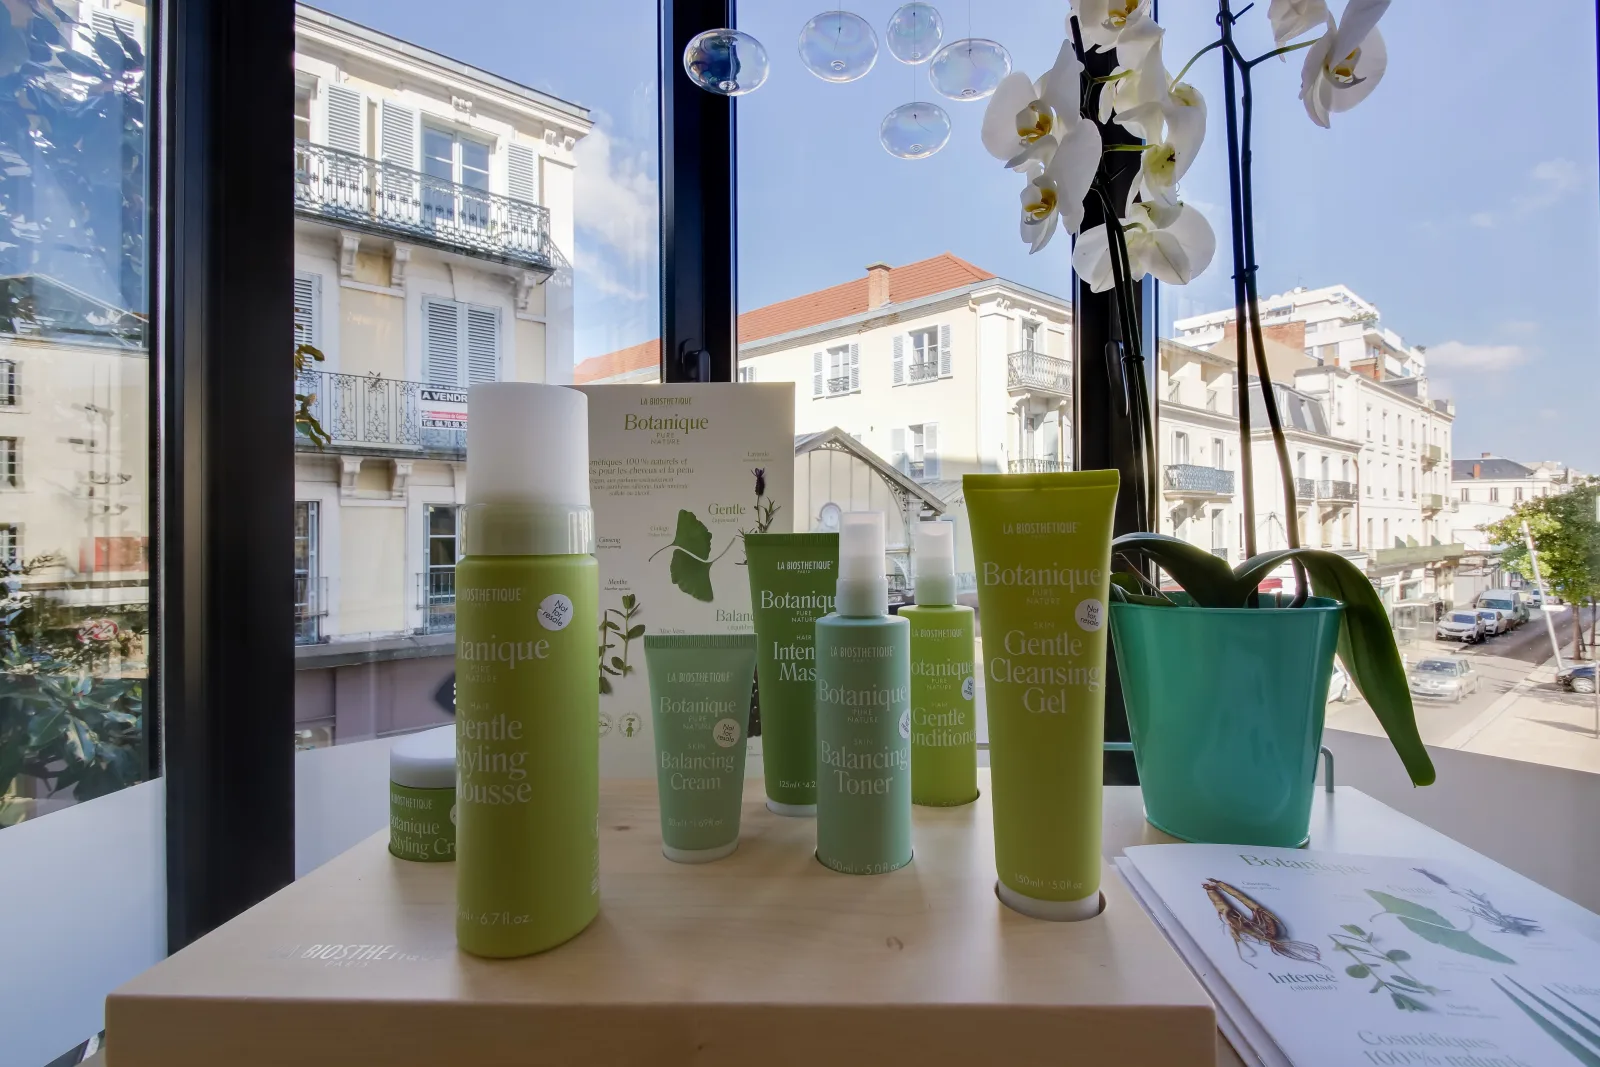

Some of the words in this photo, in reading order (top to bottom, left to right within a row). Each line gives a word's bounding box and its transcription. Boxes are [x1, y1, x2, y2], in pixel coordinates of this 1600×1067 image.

[422, 391, 431, 400] A
[432, 392, 468, 403] VENDR
[640, 398, 648, 406] LA
[649, 397, 692, 406] BIOSTHETIQUE
[624, 413, 709, 434] Botanique
[708, 502, 746, 516] Gentle
[1003, 523, 1014, 535] LA
[1016, 522, 1078, 534] BIOSTHETIQUE
[777, 561, 785, 570] LA
[787, 561, 831, 570] BIOSTHETIQUE
[983, 562, 1101, 593] Botanique
[554, 600, 569, 613] Not
[761, 590, 837, 613] Botaniqu
[1086, 604, 1099, 614] Not
[542, 611, 563, 627] resale
[552, 607, 562, 617] for
[1034, 622, 1055, 630] SKIN
[460, 634, 550, 670] tanique
[773, 641, 815, 660] Inten
[840, 646, 893, 658] BIOSTHETIQUE
[1004, 630, 1083, 656] Gentle
[667, 673, 676, 682] LA
[679, 672, 730, 682] BIOSTHETIQUE
[779, 662, 817, 681] Mas
[911, 658, 973, 680] otanique
[990, 657, 1101, 692] Cleansing
[819, 678, 907, 712] Botanique
[1023, 687, 1067, 714] Gel
[660, 696, 736, 717] Botanique
[847, 716, 879, 724] NATURE
[913, 707, 965, 727] Gentle
[661, 751, 735, 773] Balancing
[821, 740, 908, 770] Balancing
[670, 772, 722, 791] Cream
[834, 769, 893, 795] Toner
[457, 778, 532, 805] ousse
[1267, 971, 1338, 985] Intense
[1357, 1029, 1500, 1053] Cosmétiques
